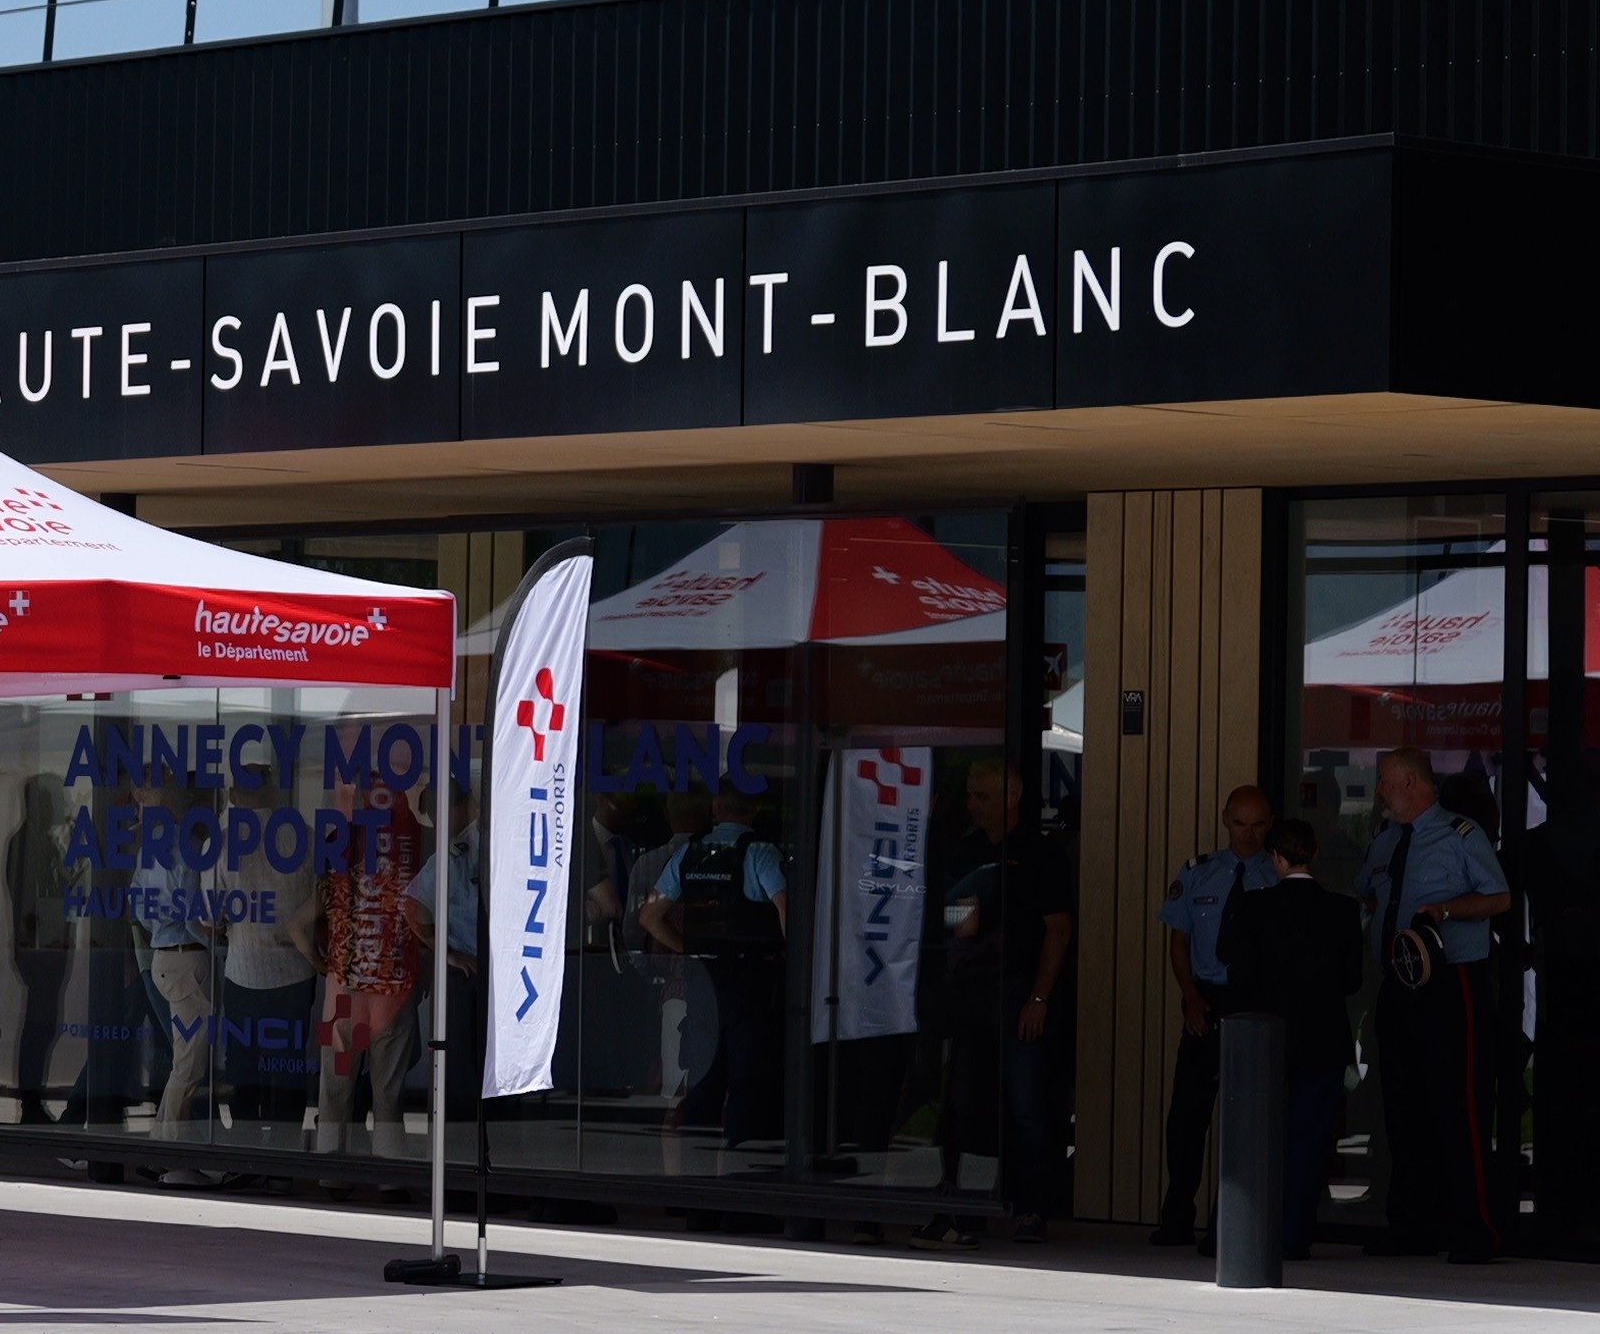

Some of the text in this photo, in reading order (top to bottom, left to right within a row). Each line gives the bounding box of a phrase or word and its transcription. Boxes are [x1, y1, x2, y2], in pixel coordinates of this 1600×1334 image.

[541, 241, 1196, 369] MONT-BLANC
[198, 641, 309, 663] le Département
[63, 724, 306, 790] ANNECY
[63, 805, 393, 876] AEROPORT
[554, 762, 565, 868] AIRPORTS
[515, 787, 549, 1023] VINCI
[864, 821, 900, 987] VINCI
[171, 1014, 307, 1052] VINCI
